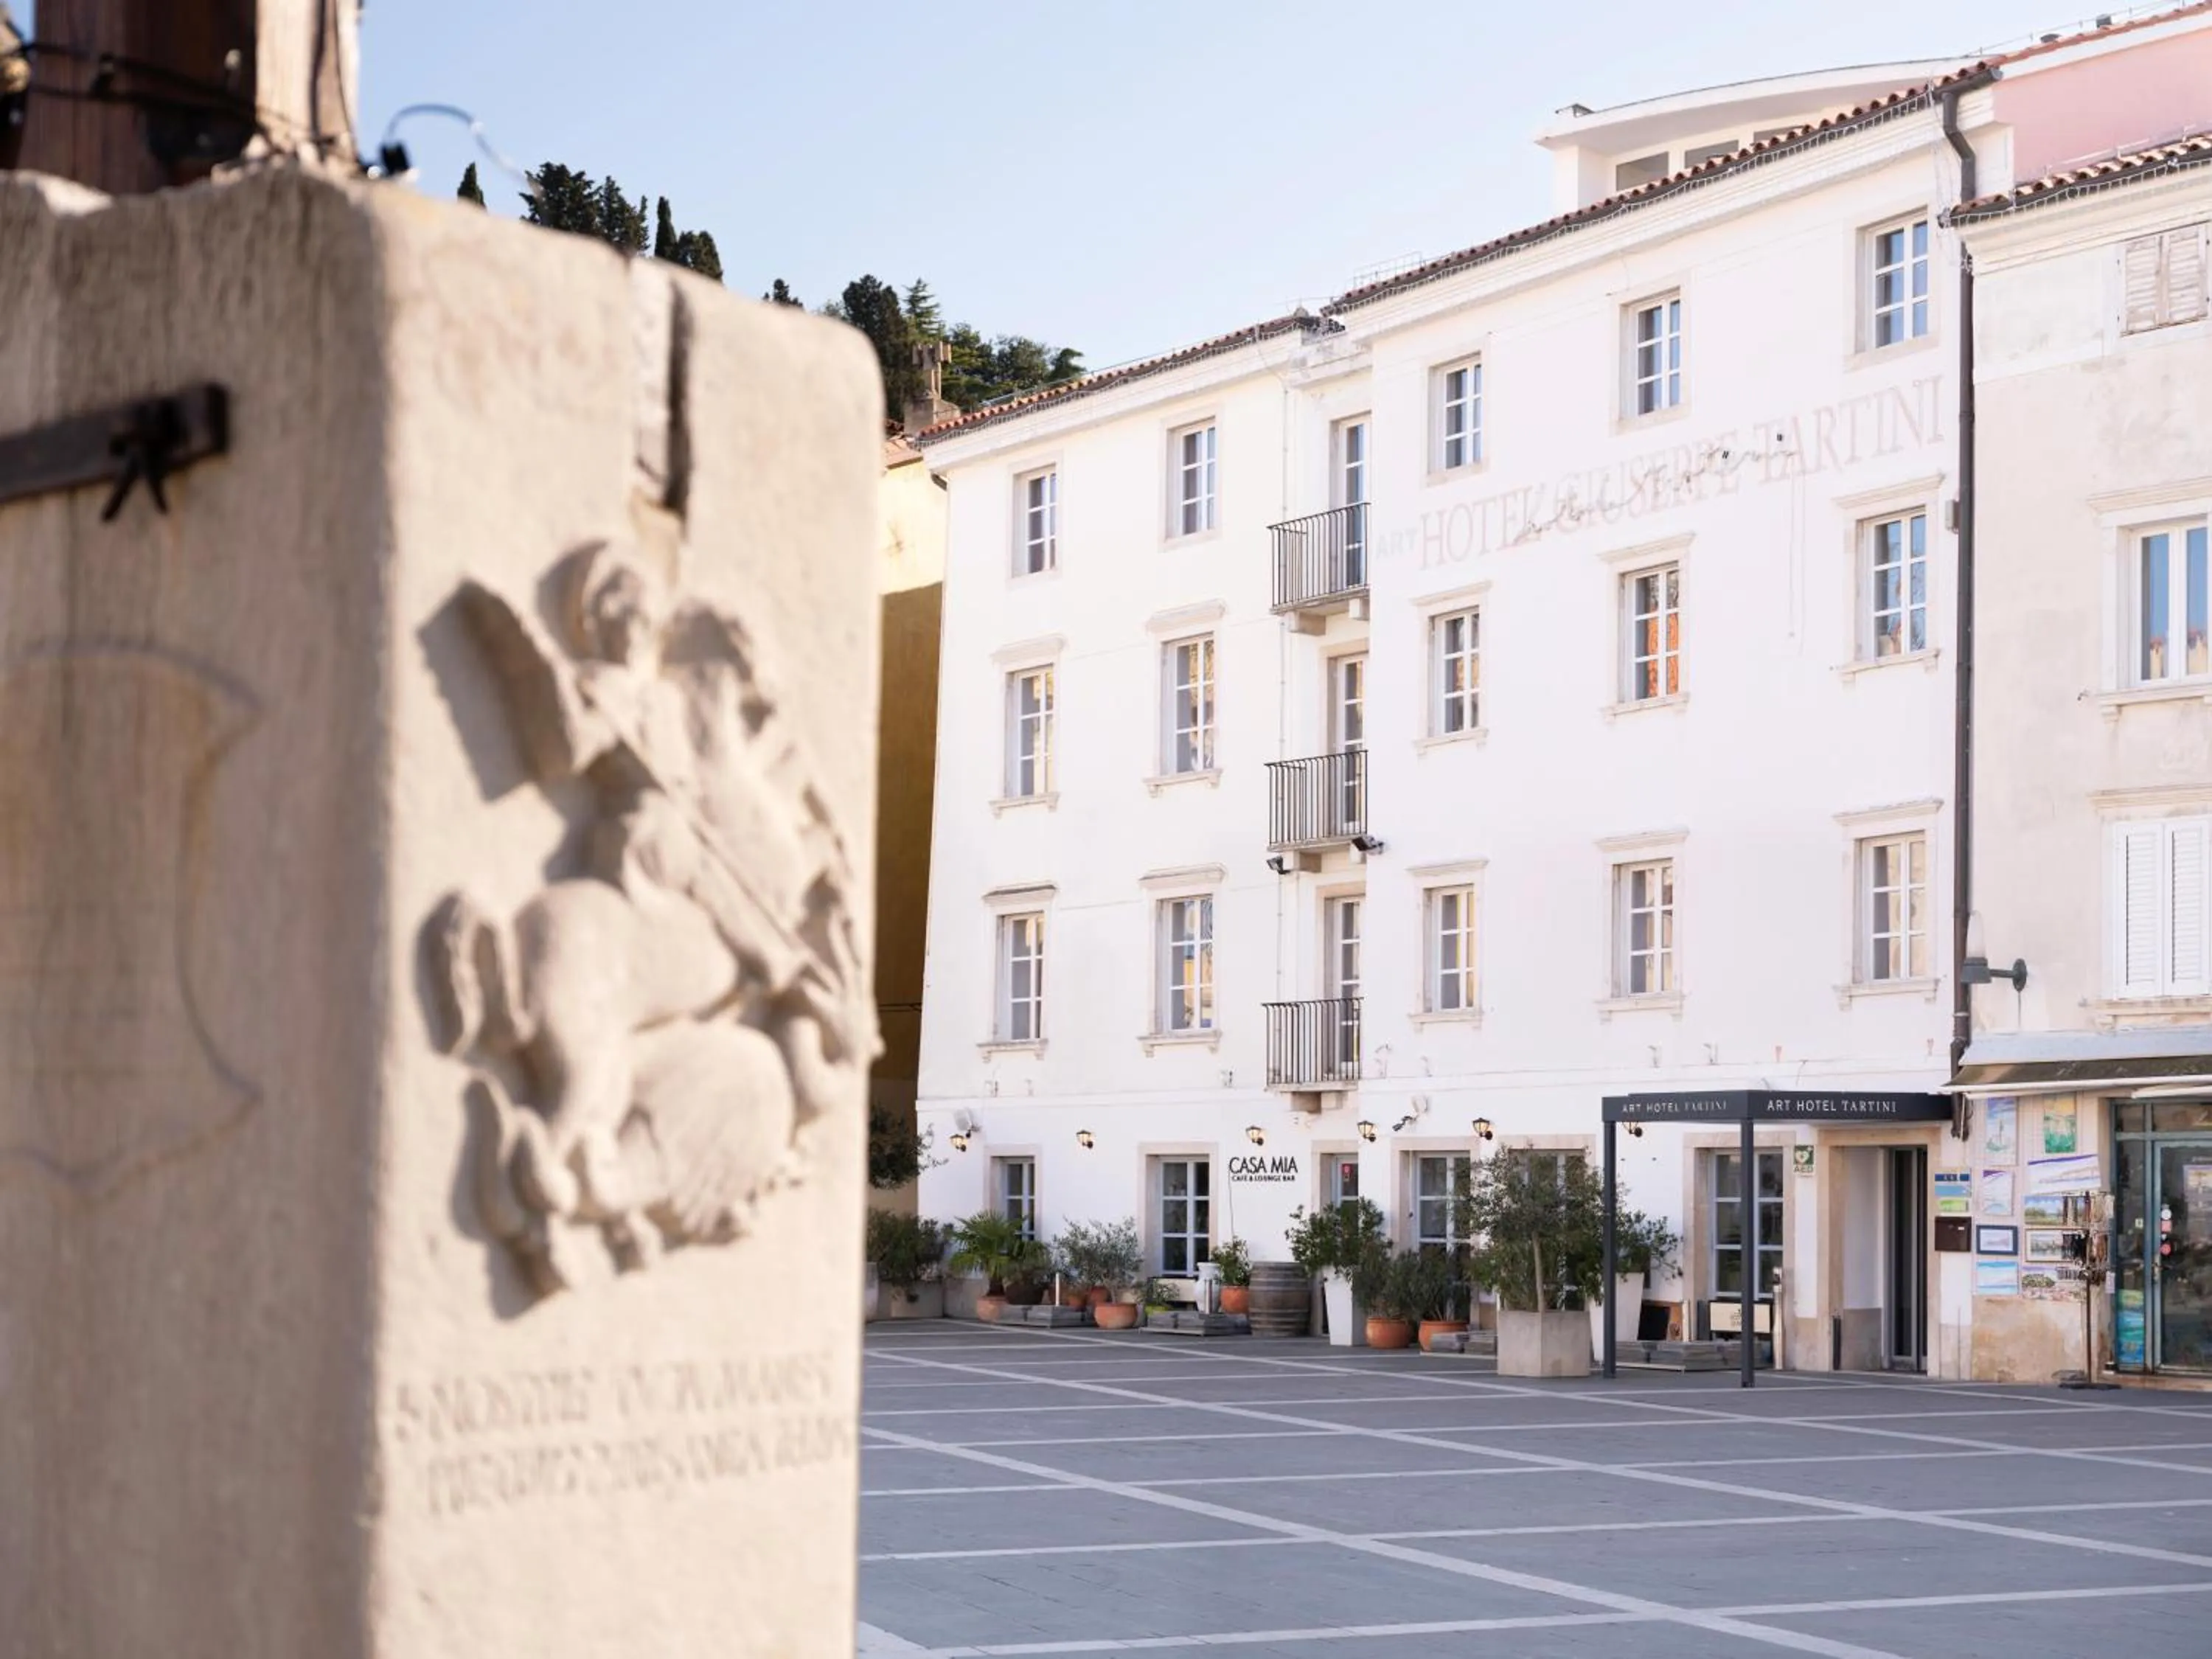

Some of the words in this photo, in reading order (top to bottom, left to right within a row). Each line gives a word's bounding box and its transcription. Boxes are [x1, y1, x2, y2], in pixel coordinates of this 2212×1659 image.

[1752, 375, 1945, 485] TARTINI
[1622, 1103, 1641, 1113] ART
[1646, 1102, 1680, 1113] HOTEL
[1767, 1099, 1790, 1111] ART
[1797, 1099, 1837, 1112] HOTEL
[1841, 1100, 1896, 1113] TARTINI
[1229, 1156, 1267, 1174] CASA
[1270, 1156, 1298, 1173] MIA
[1283, 1174, 1295, 1182] BAR
